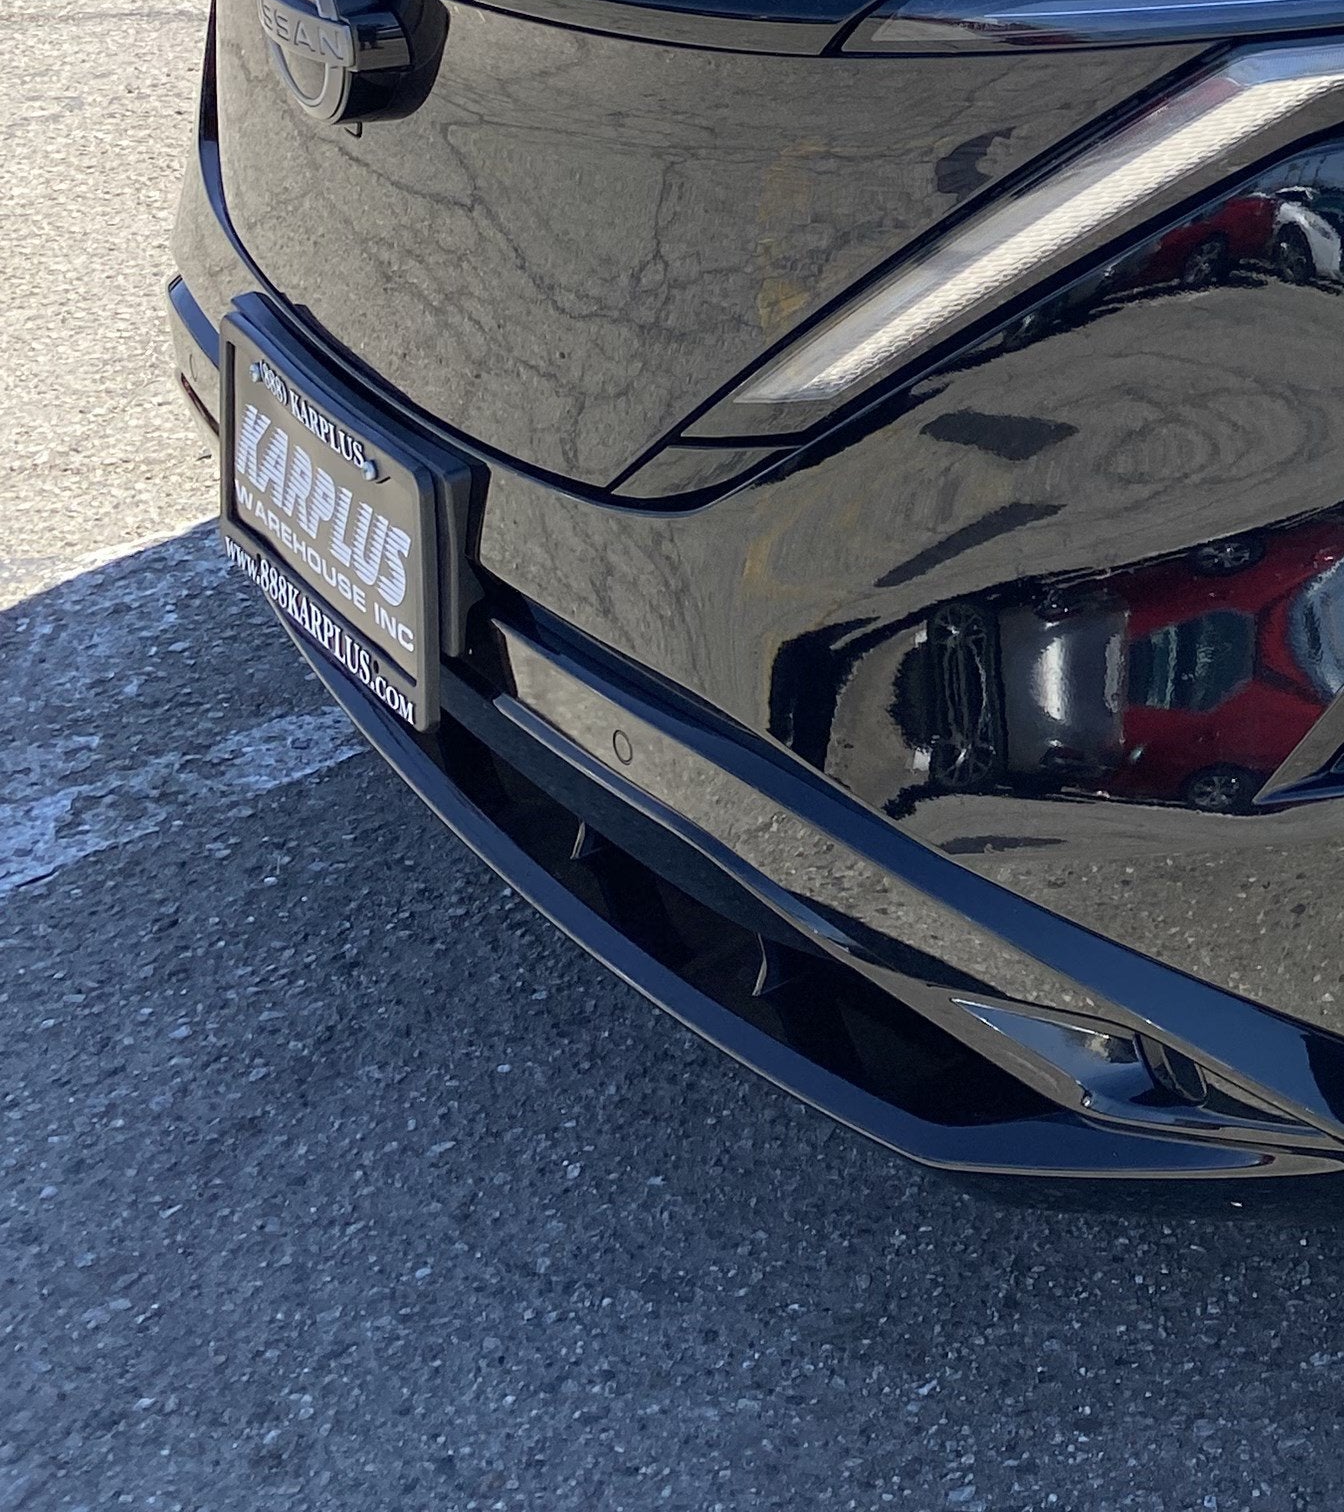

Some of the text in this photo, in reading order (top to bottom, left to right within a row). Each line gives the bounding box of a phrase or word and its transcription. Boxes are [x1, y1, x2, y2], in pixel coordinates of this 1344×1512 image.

[235, 403, 412, 607] KARPLUS
[289, 390, 365, 468] KARPLUS
[234, 479, 415, 652] WAREHOUSE INC
